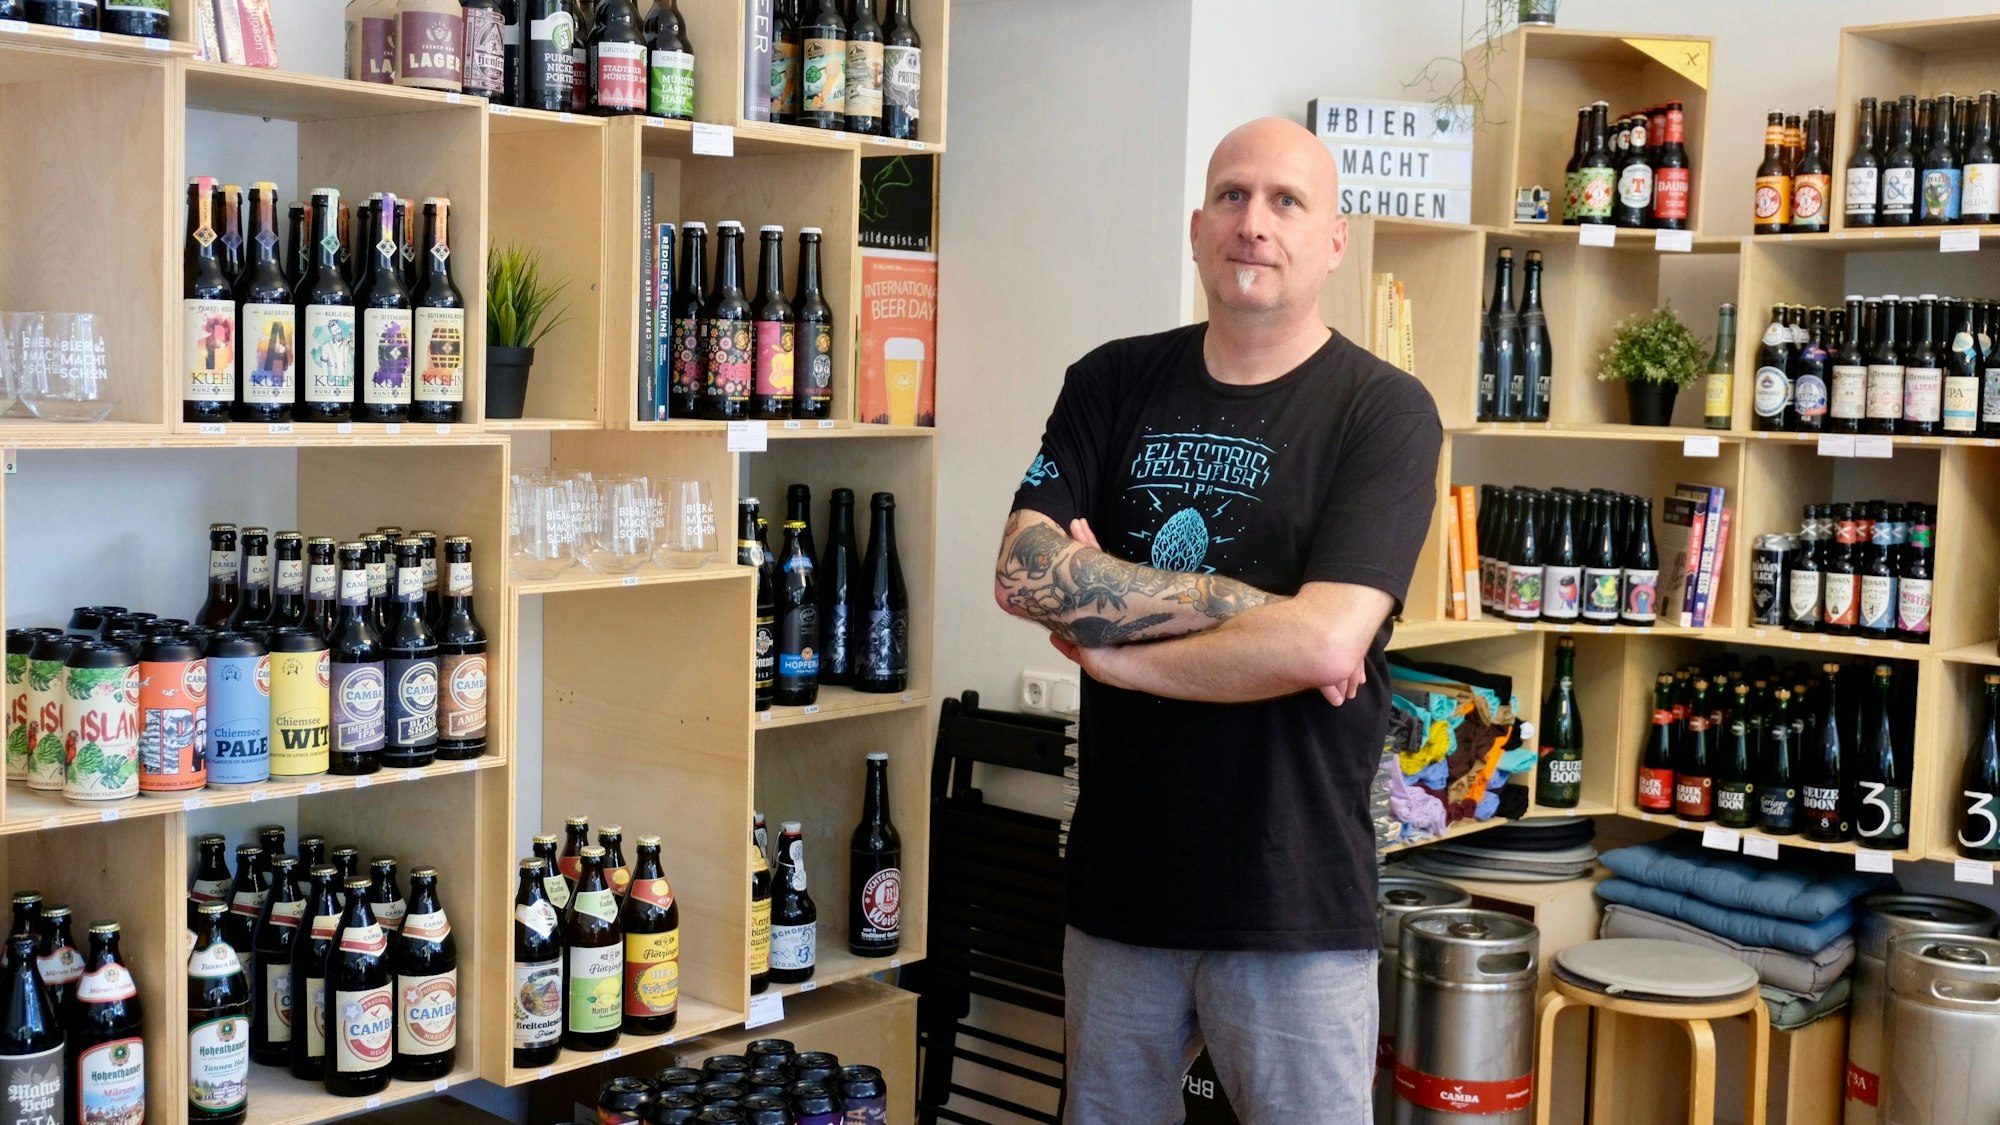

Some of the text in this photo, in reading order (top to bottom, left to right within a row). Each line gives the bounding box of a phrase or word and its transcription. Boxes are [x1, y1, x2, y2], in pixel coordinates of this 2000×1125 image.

[754, 0, 768, 53] EER
[409, 52, 460, 72] LAGER
[544, 52, 573, 63] PUMPE
[547, 63, 573, 74] NICKE
[603, 64, 642, 74] STADTBIER
[545, 72, 573, 83] PORTE
[897, 70, 920, 84] PROTOT
[662, 95, 688, 105] HANF
[1327, 107, 1416, 137] #BIER
[1342, 149, 1430, 177] MACHT
[1341, 189, 1446, 219] SCHOEN
[864, 280, 936, 300] INTERNATIONA
[871, 299, 936, 322] BEER DAY
[60, 340, 93, 351] BIER
[60, 354, 107, 366] MACHT
[60, 366, 108, 379] SCHÖN
[1144, 441, 1268, 473] ELECTRIC
[1136, 460, 1262, 489] JELLYFISH
[1183, 482, 1214, 499] IPA
[619, 507, 641, 516] BIER
[686, 503, 707, 513] BIER
[619, 518, 648, 528] MACHT
[686, 515, 714, 525] MACHT
[345, 689, 383, 701] CAMBA
[80, 709, 139, 742] ISLAN
[276, 717, 321, 727] Chiemsee
[347, 719, 383, 736] IMPERIAL
[409, 713, 437, 728] BLACK
[214, 728, 261, 739] Chiemsee
[281, 727, 329, 749] WIT
[358, 727, 376, 738] IPA
[215, 737, 268, 758] PALE
[1549, 760, 1582, 772] GEUZE
[1549, 771, 1582, 783] BOON
[1803, 785, 1840, 799] GEUZE
[1718, 800, 1745, 810] BOON
[1803, 797, 1836, 811] BOON
[1856, 781, 1891, 837] 3
[1820, 817, 1829, 828] 8
[1957, 790, 1998, 848] 3
[200, 960, 227, 971] Tannen
[409, 1004, 457, 1020] CAMBA
[199, 1038, 247, 1057] Hohenthanner
[370, 1047, 386, 1056] HELL
[91, 1063, 142, 1082] Hohenthanner
[204, 1062, 231, 1073] Tannen
[7, 1079, 61, 1101] Mahrs
[101, 1085, 136, 1099] Märzen
[1439, 1091, 1480, 1104] CAMBA
[20, 1097, 55, 1114] Bräu
